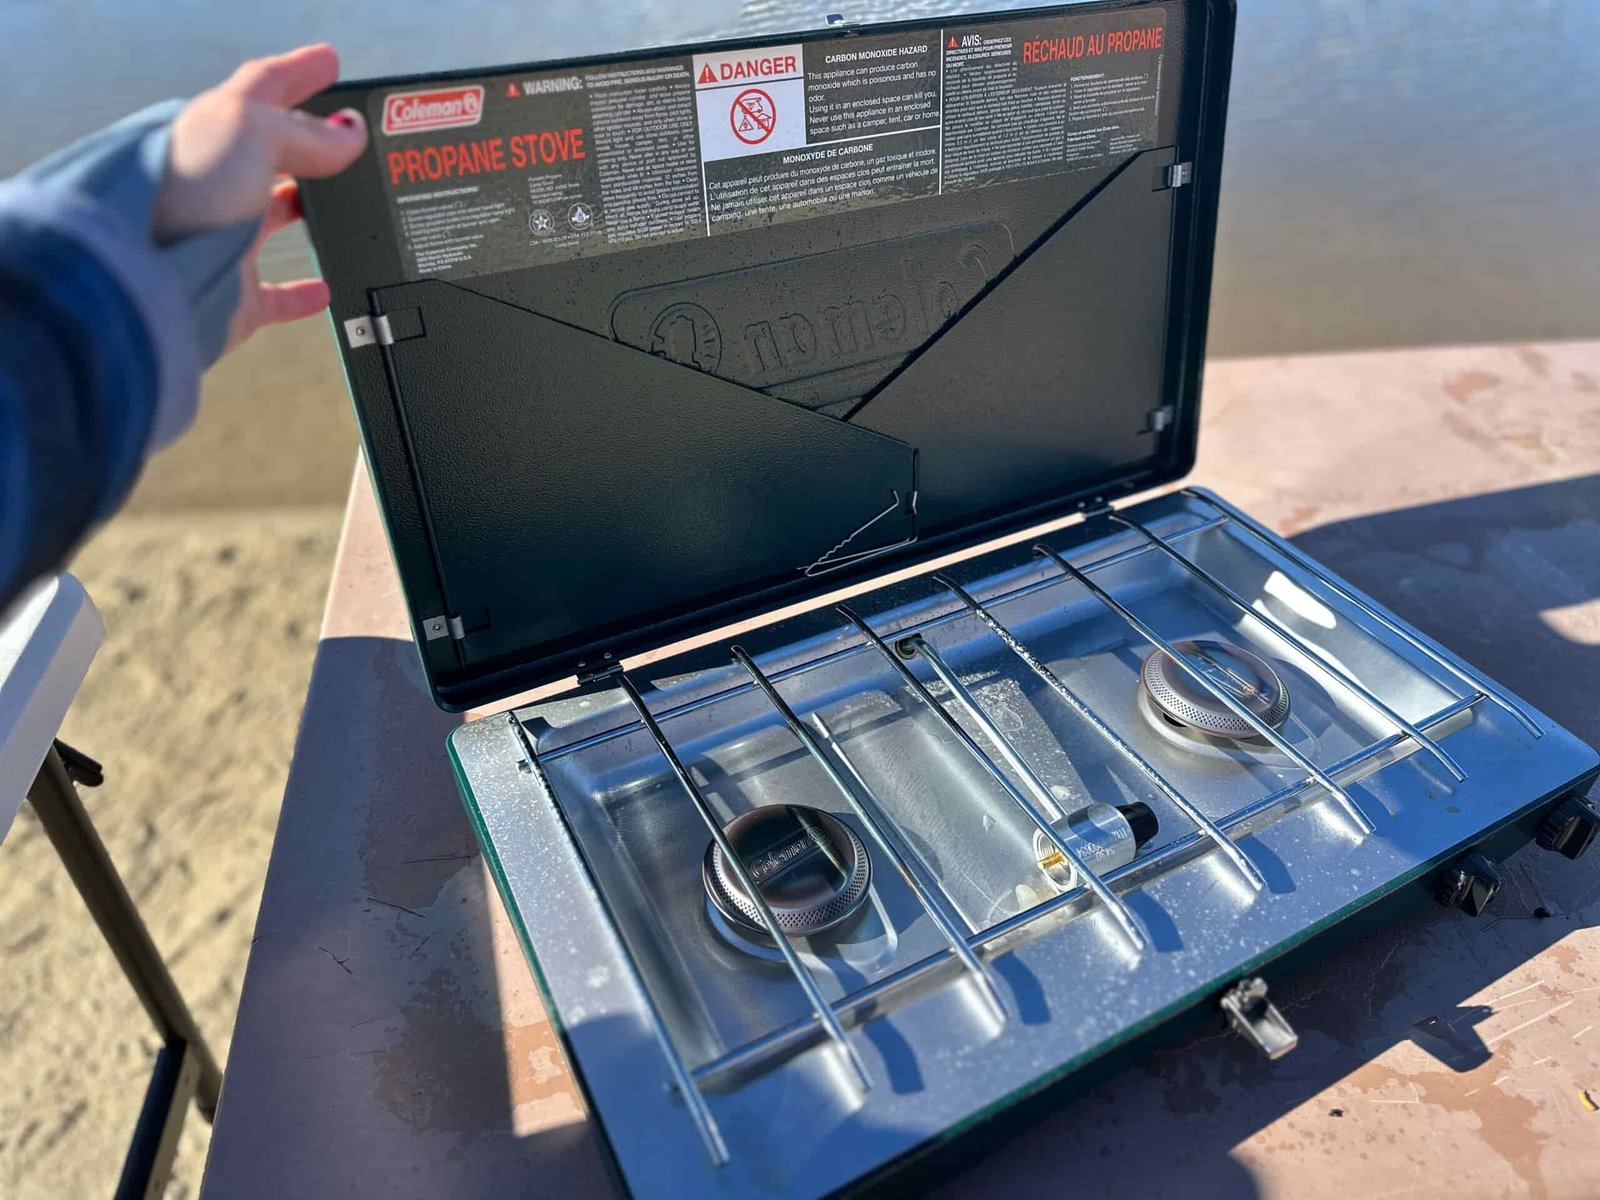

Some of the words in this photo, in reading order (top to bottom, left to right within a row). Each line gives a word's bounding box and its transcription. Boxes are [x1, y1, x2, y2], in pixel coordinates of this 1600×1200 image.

[961, 34, 982, 48] AVIS:
[1022, 34, 1085, 64] RÉCHAUD
[1086, 32, 1105, 57] AU
[1107, 26, 1163, 54] PROPANE
[825, 52, 858, 64] CARBON
[858, 48, 898, 60] MONOXIDE
[898, 44, 928, 56] HAZARD
[720, 55, 797, 81] DANGER
[808, 72, 822, 80] This
[823, 69, 855, 79] appliance
[869, 64, 895, 75] produce
[896, 61, 918, 70] carbon
[522, 76, 583, 96] WARNING:
[808, 80, 840, 91] monoxide
[842, 78, 861, 87] which
[862, 77, 868, 85] is
[869, 74, 901, 85] poisonous
[902, 70, 915, 80] and
[915, 70, 926, 78] has
[390, 97, 462, 122] Coleman
[808, 94, 825, 103] odor.
[809, 105, 828, 113] Using
[829, 103, 834, 111] it
[835, 102, 841, 110] in
[852, 97, 880, 108] enclosed
[882, 95, 900, 105] space
[914, 91, 923, 99] kill
[924, 91, 937, 100] you.
[809, 115, 829, 124] Never
[843, 111, 855, 119] this
[856, 108, 886, 118] appliance
[903, 100, 931, 111] enclosed
[809, 126, 830, 135] space
[831, 122, 847, 132] such
[848, 122, 856, 130] as
[862, 118, 887, 127] camper,
[888, 115, 902, 123] tent,
[386, 138, 508, 186] PROPANE
[510, 127, 586, 169] STOVE
[782, 150, 826, 164] MONOXYDE
[826, 148, 837, 158] DE
[838, 143, 874, 156] CARBONE
[708, 181, 721, 190] Cet
[722, 177, 747, 188] appareil
[748, 175, 763, 185] peut
[763, 171, 789, 183] produire
[790, 169, 799, 177] du
[799, 164, 831, 175] monoxyde
[831, 162, 839, 171] de
[840, 159, 866, 170] carbone,
[875, 156, 886, 166] gaz
[886, 152, 907, 162] toxique
[709, 189, 748, 201] L'utilisation
[760, 184, 771, 193] cet
[772, 180, 798, 191] appareil
[799, 178, 815, 187] dans
[816, 175, 829, 183] des
[829, 172, 856, 182] espaces
[857, 169, 870, 178] clos
[871, 166, 885, 176] peut
[710, 203, 721, 211] Ne
[722, 200, 745, 211] jamais
[745, 196, 768, 206] utiliser
[768, 193, 780, 202] cet
[781, 189, 807, 200] appareil
[807, 187, 824, 195] dans
[834, 181, 857, 191] espace
[872, 175, 895, 184] comme
[896, 173, 904, 181] un
[905, 168, 930, 178] véhicule
[930, 167, 938, 175] de
[744, 208, 758, 217] une
[758, 205, 777, 214] tente,
[778, 203, 791, 211] une
[792, 196, 828, 209] automobile
[838, 192, 850, 200] une
